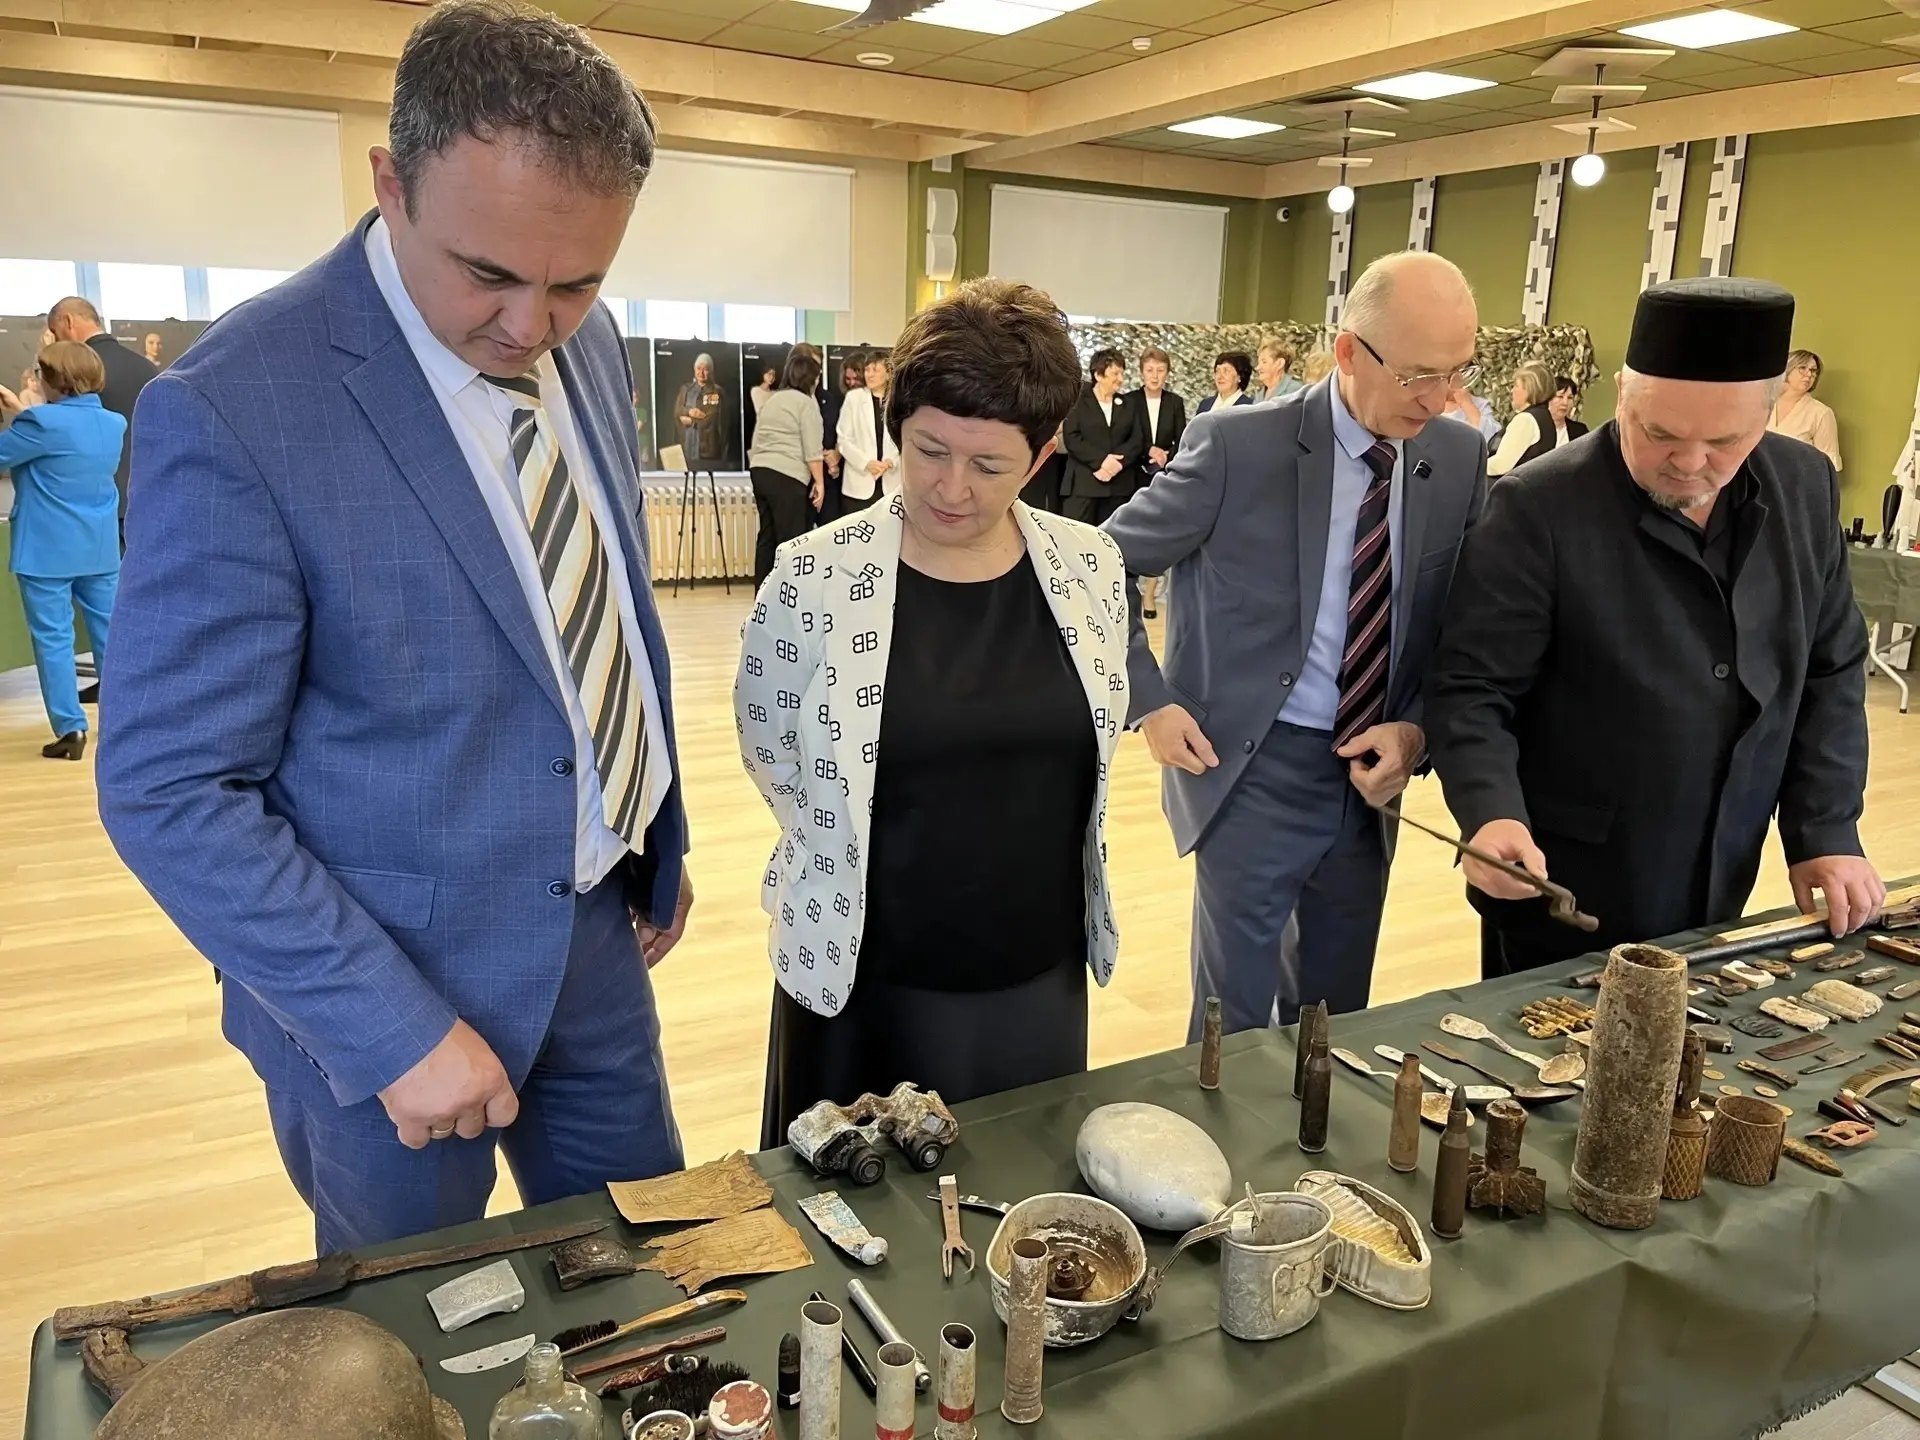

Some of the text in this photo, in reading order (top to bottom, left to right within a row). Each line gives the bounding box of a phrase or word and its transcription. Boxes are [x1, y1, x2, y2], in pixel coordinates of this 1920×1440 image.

[779, 581, 798, 608] BB
[849, 578, 874, 601] BB
[776, 639, 798, 663] BB
[852, 631, 878, 654] BB
[746, 655, 762, 677] BB
[777, 690, 800, 709] BB
[856, 684, 882, 708] BB
[748, 704, 767, 722] BB
[756, 747, 775, 764] BB
[815, 758, 837, 780] BB
[772, 783, 794, 796] BB
[814, 808, 835, 829] BB
[815, 854, 834, 875] BB
[782, 902, 794, 927] BB
[806, 898, 821, 923] BB
[833, 891, 850, 917] BB
[778, 948, 789, 973] BB
[799, 946, 814, 970] BB
[826, 941, 840, 965] BB
[822, 988, 837, 1011] BB
